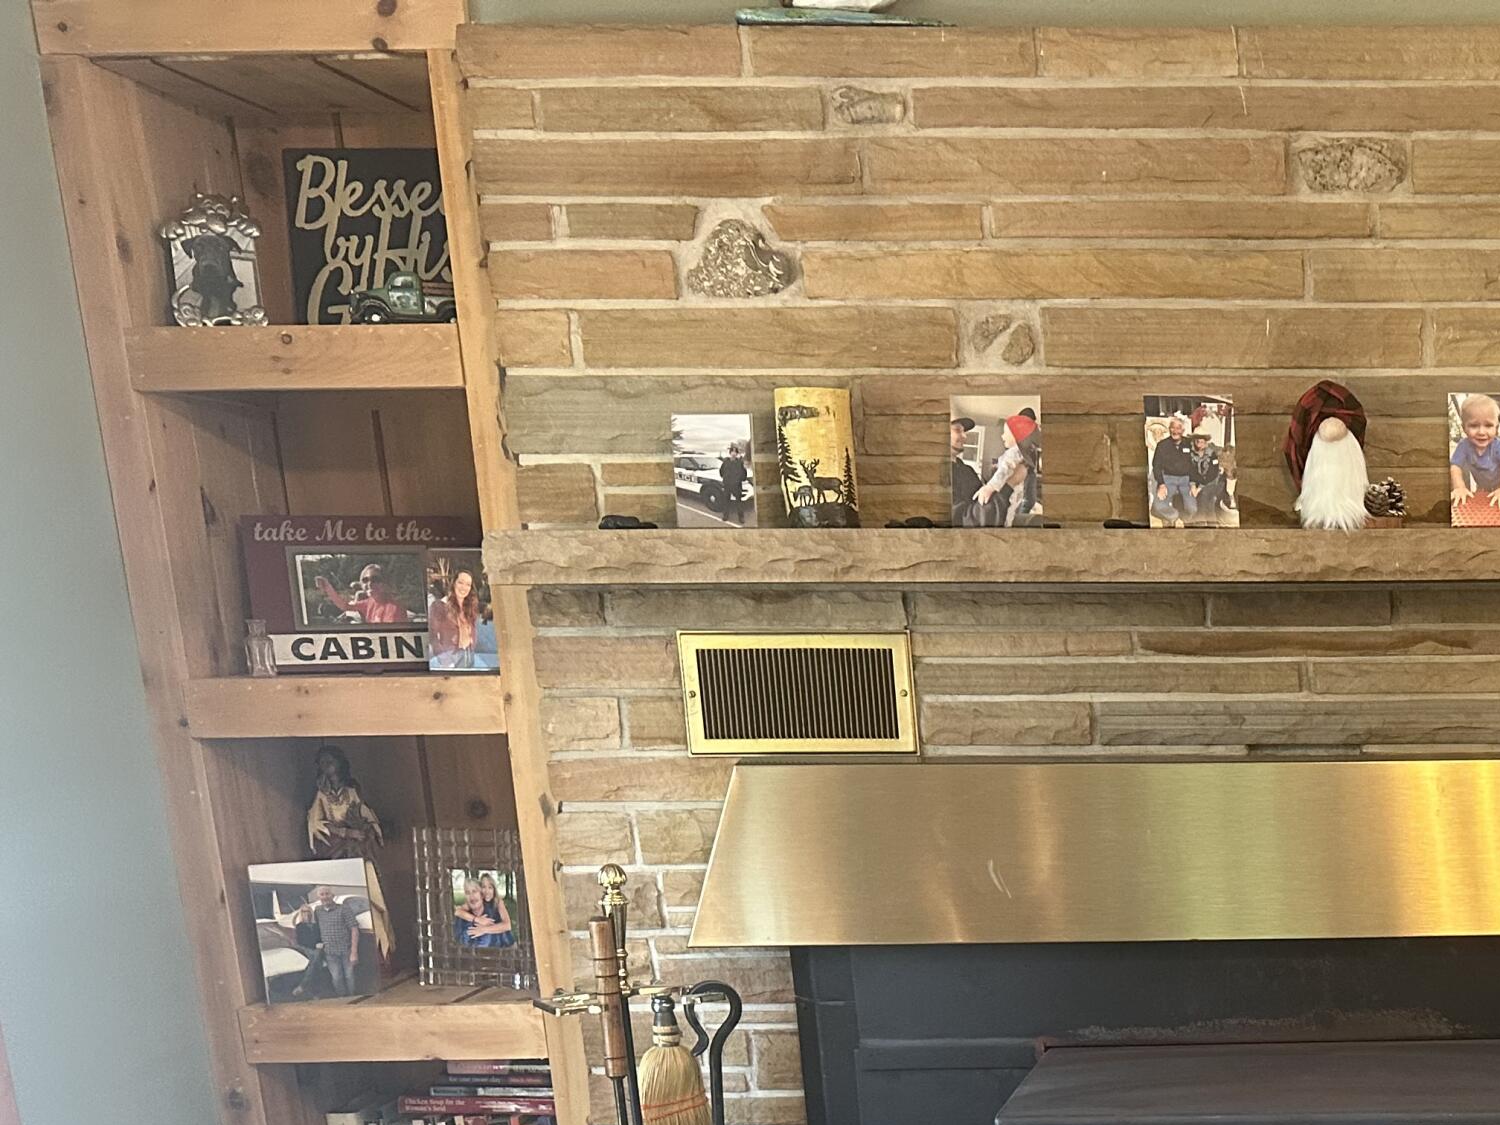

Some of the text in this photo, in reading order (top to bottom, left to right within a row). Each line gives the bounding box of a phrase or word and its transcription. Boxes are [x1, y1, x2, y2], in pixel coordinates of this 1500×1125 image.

[295, 154, 446, 230] Blesse
[324, 214, 374, 291] by
[675, 473, 698, 483] LICE
[254, 520, 306, 541] take
[316, 519, 359, 542] Me
[365, 522, 389, 541] to
[291, 635, 425, 662] CABIN
